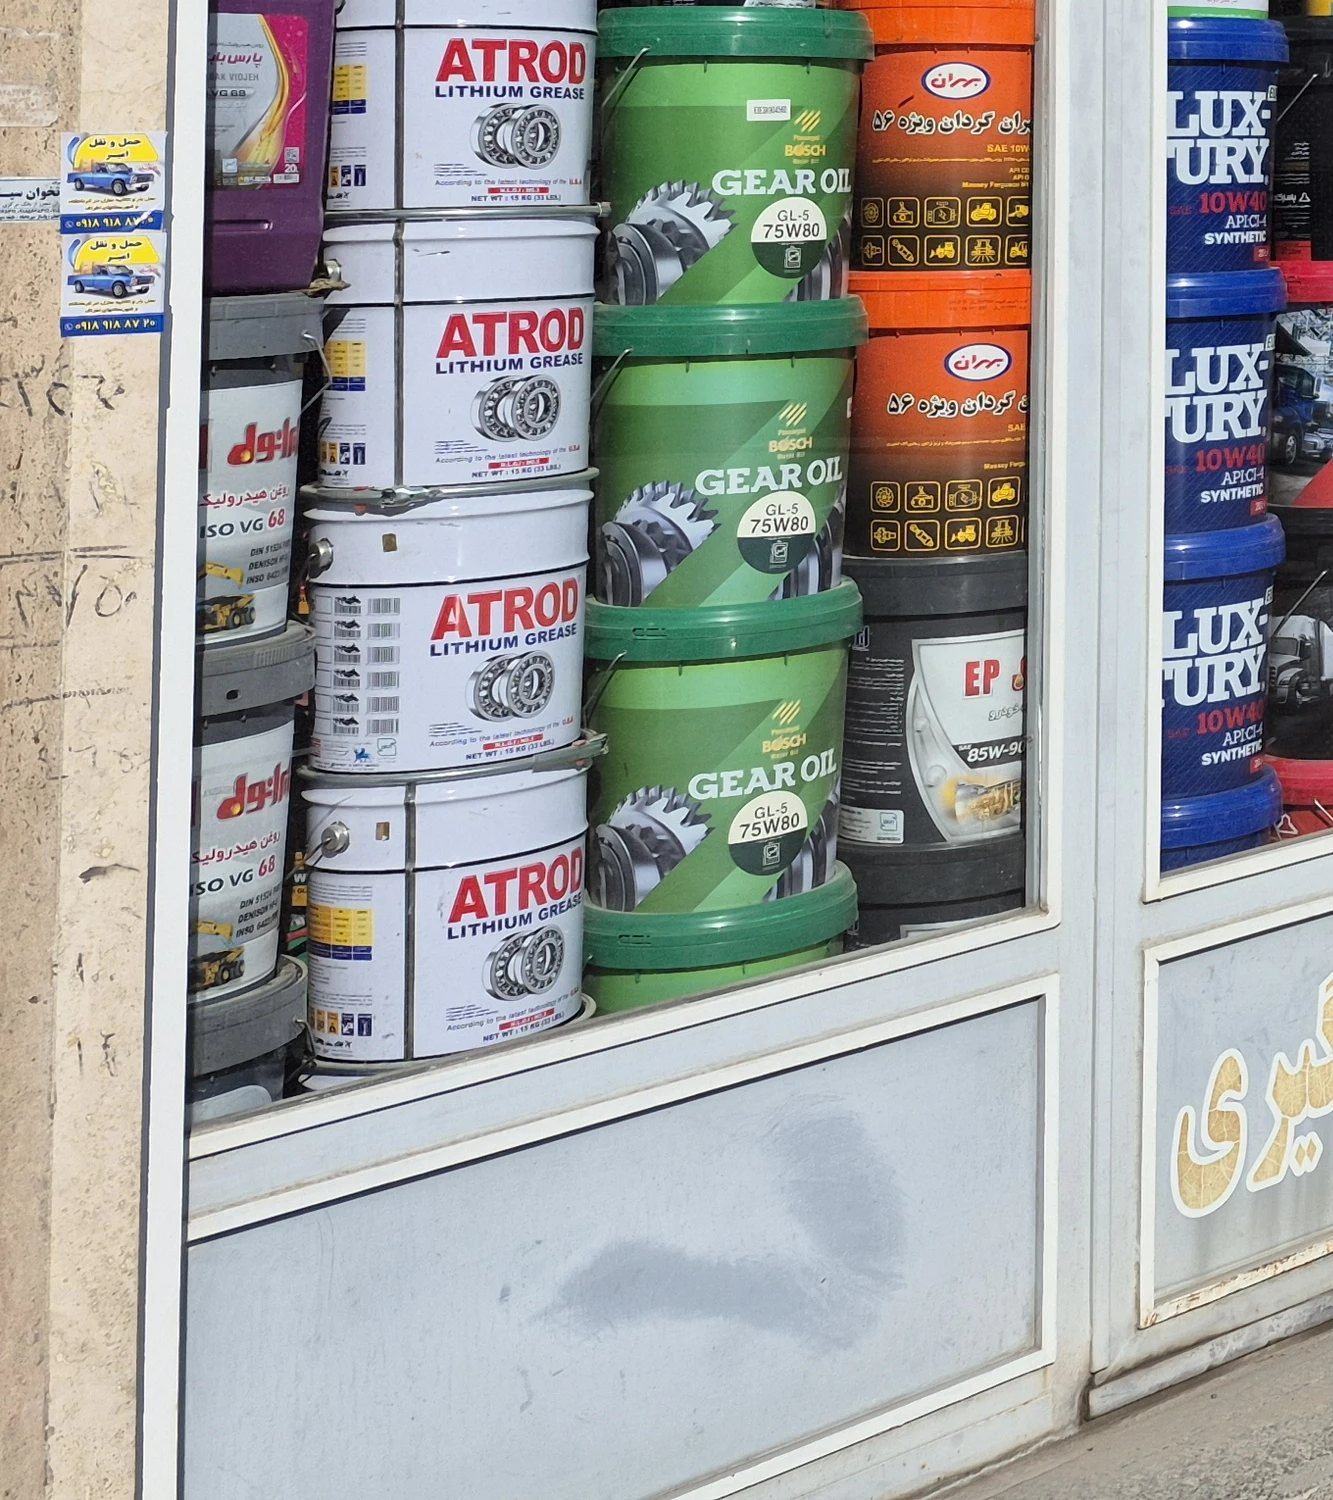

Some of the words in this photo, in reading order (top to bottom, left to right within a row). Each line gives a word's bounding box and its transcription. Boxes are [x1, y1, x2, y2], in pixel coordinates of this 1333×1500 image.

[435, 38, 587, 84] ATROD
[435, 85, 523, 98] LITHIUM
[530, 86, 584, 99] GREASE
[930, 73, 982, 89] بهران
[873, 110, 896, 132] ۵۶
[899, 111, 936, 135] ویژه
[938, 110, 996, 134] گردان
[1168, 90, 1271, 137] LUX-
[89, 138, 106, 148] نقل
[119, 138, 141, 146] حمل
[987, 144, 1007, 153] SAE
[711, 169, 816, 196] GEAR
[820, 168, 851, 194] OIL
[1199, 191, 1268, 213] 10W40
[76, 218, 99, 228] ۰۹۱۸
[103, 218, 121, 227] ۹۱۸
[777, 209, 809, 222] GL-5
[763, 223, 820, 239] 75W80
[1204, 230, 1267, 245] SYNTHETIC
[90, 241, 107, 251] نقل
[120, 241, 142, 249] حمل
[75, 320, 99, 330] ۰۹۱۸
[103, 319, 121, 329] ۹۱۸
[125, 319, 139, 328] ۸۷
[436, 308, 584, 358] ATROD
[435, 358, 523, 374] LITHIUM
[530, 353, 583, 369] GREASE
[954, 354, 1004, 370] بهران
[1165, 343, 1269, 395] LUX-
[887, 393, 914, 414] ۵۶
[917, 394, 957, 419] ویژه
[960, 390, 1017, 416] گردان
[435, 456, 473, 464] According
[1196, 444, 1265, 471] 10W40
[695, 463, 802, 496] GEAR
[806, 456, 842, 486] OIL
[1200, 482, 1264, 503] SYNTHETIC
[765, 503, 798, 516] GL-5
[201, 523, 234, 539] ISO
[240, 517, 263, 533] VG
[268, 508, 285, 528] 68
[750, 515, 809, 534] 75W80
[431, 578, 578, 641] ATROD
[1162, 598, 1268, 659] LUX-
[430, 635, 519, 657] LITHIUM
[525, 623, 577, 645] GREASE
[965, 659, 1001, 698] EP
[466, 752, 482, 760] NET
[1201, 738, 1262, 766] SYNTHETIC
[688, 761, 796, 800] GEAR
[800, 747, 837, 782] OIL
[754, 801, 789, 820] GL-5
[739, 814, 800, 839] 75W80
[190, 878, 224, 896] ISO
[229, 868, 254, 887] VG
[258, 855, 275, 878] 68
[448, 847, 583, 924] ATROD
[447, 912, 532, 940] LITHIUM
[538, 892, 582, 921] GREASE
[483, 1034, 499, 1042] NET
